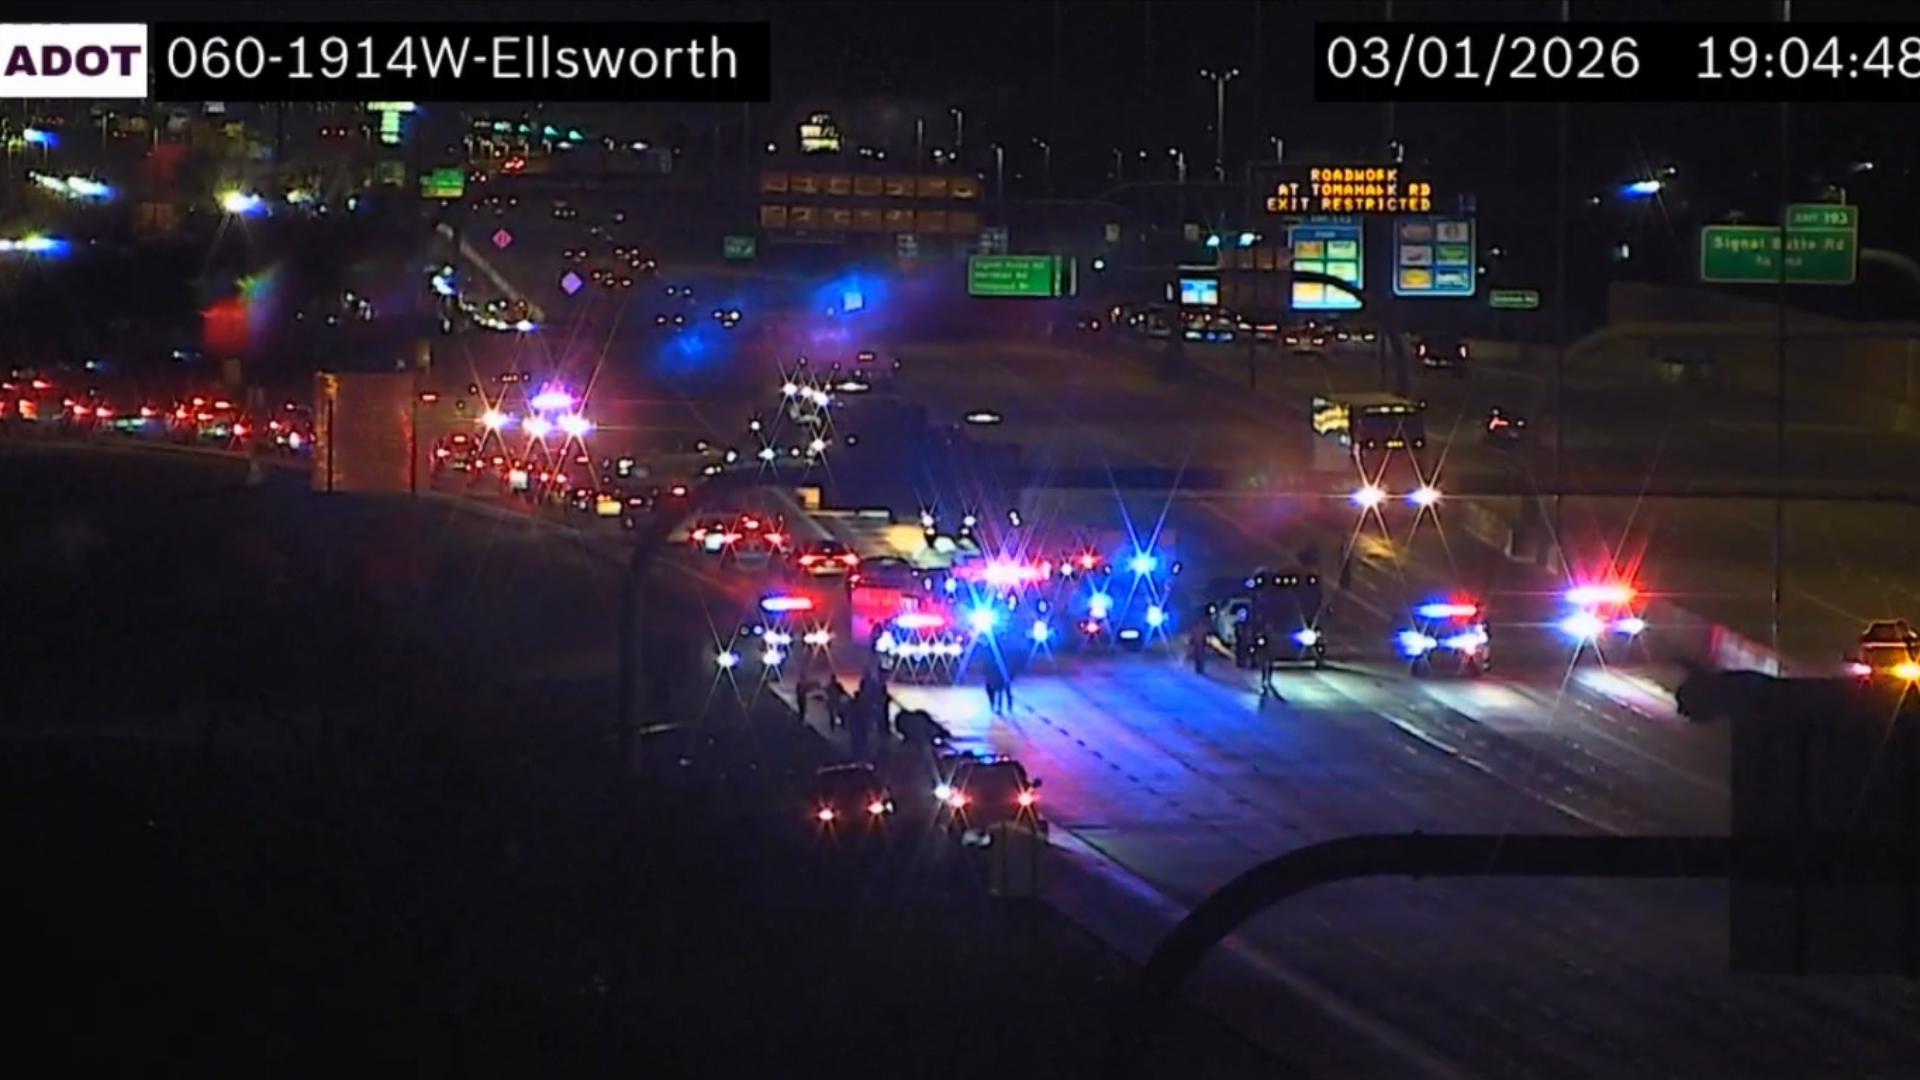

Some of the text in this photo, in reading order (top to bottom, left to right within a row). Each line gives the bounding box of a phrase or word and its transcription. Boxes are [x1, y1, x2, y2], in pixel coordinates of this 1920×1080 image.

[1310, 168, 1397, 182] ROADWORK
[1278, 182, 1299, 196] AT
[1408, 182, 1431, 197] RD
[1266, 197, 1432, 212] EXIT RESTRICTED
[1714, 236, 1765, 253] Signal
